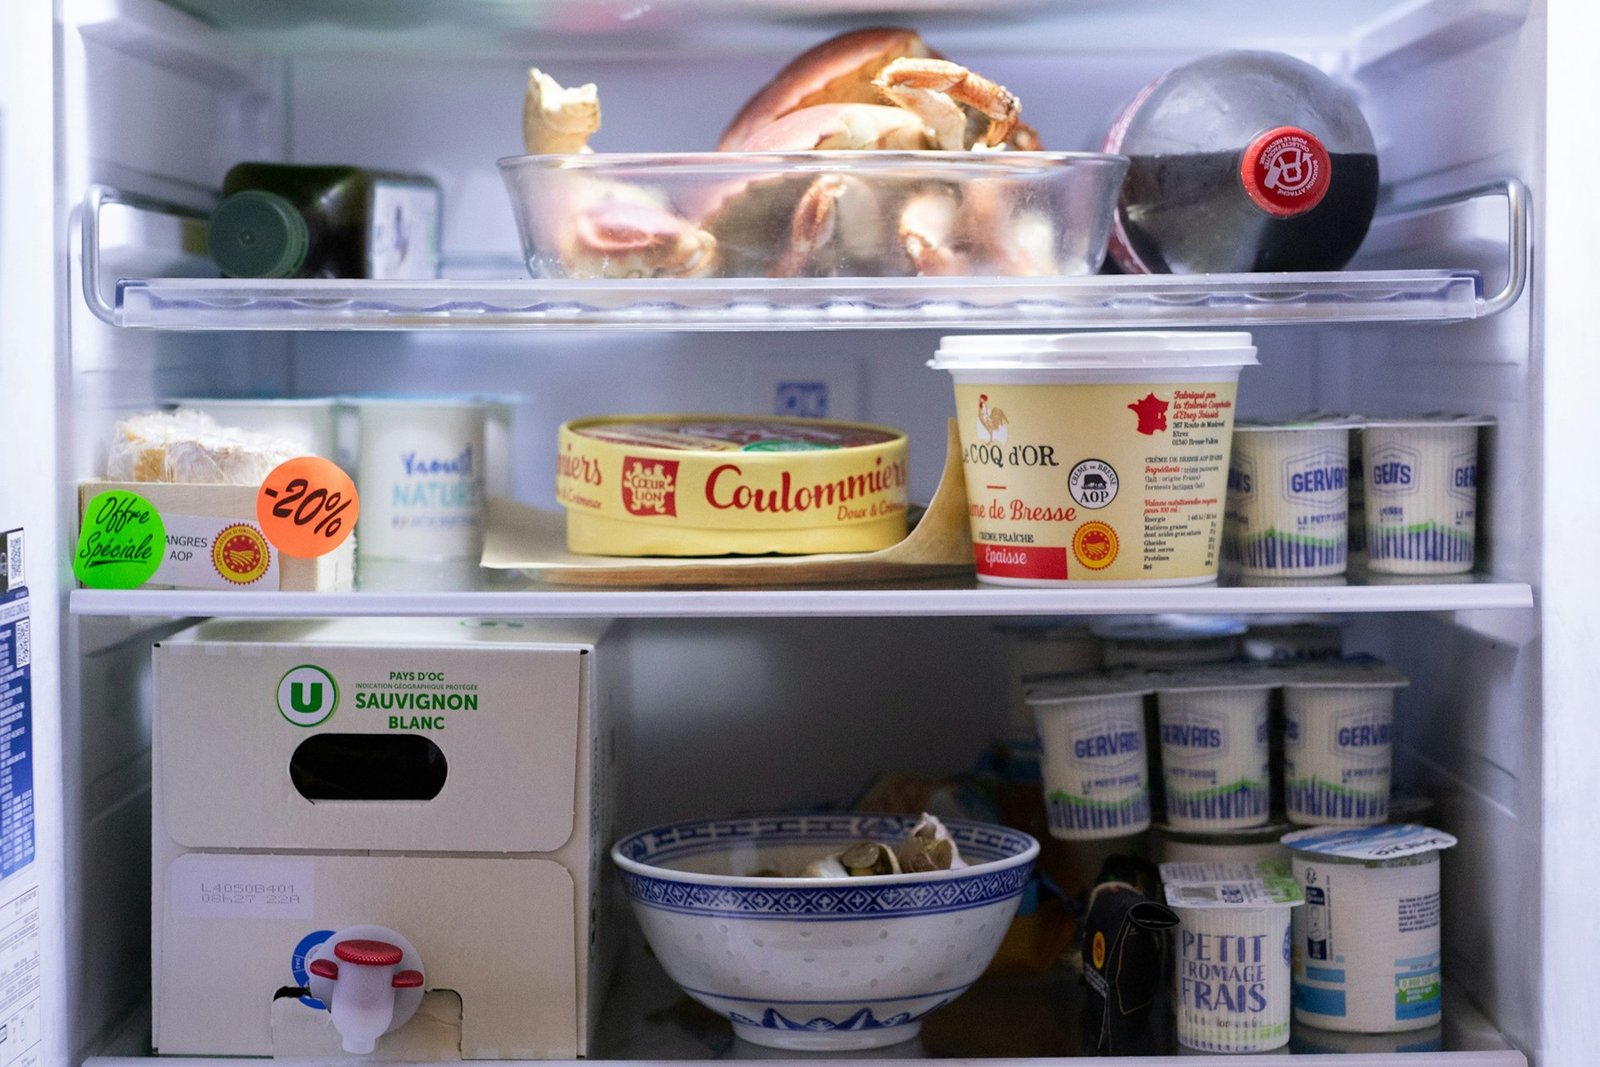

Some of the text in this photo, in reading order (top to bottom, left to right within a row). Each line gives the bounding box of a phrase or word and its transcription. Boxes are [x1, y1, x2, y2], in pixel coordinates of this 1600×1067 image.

[970, 444, 1004, 468] COQ
[1008, 444, 1060, 467] d'OR
[1097, 463, 1117, 486] BRESSE
[265, 478, 352, 538] -20%
[1080, 490, 1109, 504] AOP
[95, 496, 150, 534] Offre
[989, 498, 1006, 520] de
[1009, 499, 1078, 521] Bresse
[80, 532, 153, 569] Spéciale
[164, 534, 208, 549] ANGRES
[169, 550, 193, 562] AOP
[389, 671, 445, 681] PAYS D'OC
[394, 683, 444, 691] GÉOGRAPHIQUE
[291, 683, 323, 714] U
[355, 692, 478, 711] SAUVIGNON
[388, 716, 445, 730] BLANC
[1182, 929, 1268, 963] PETIT
[1182, 959, 1266, 983] FROMAGE
[1182, 977, 1267, 1014] FRAIS
